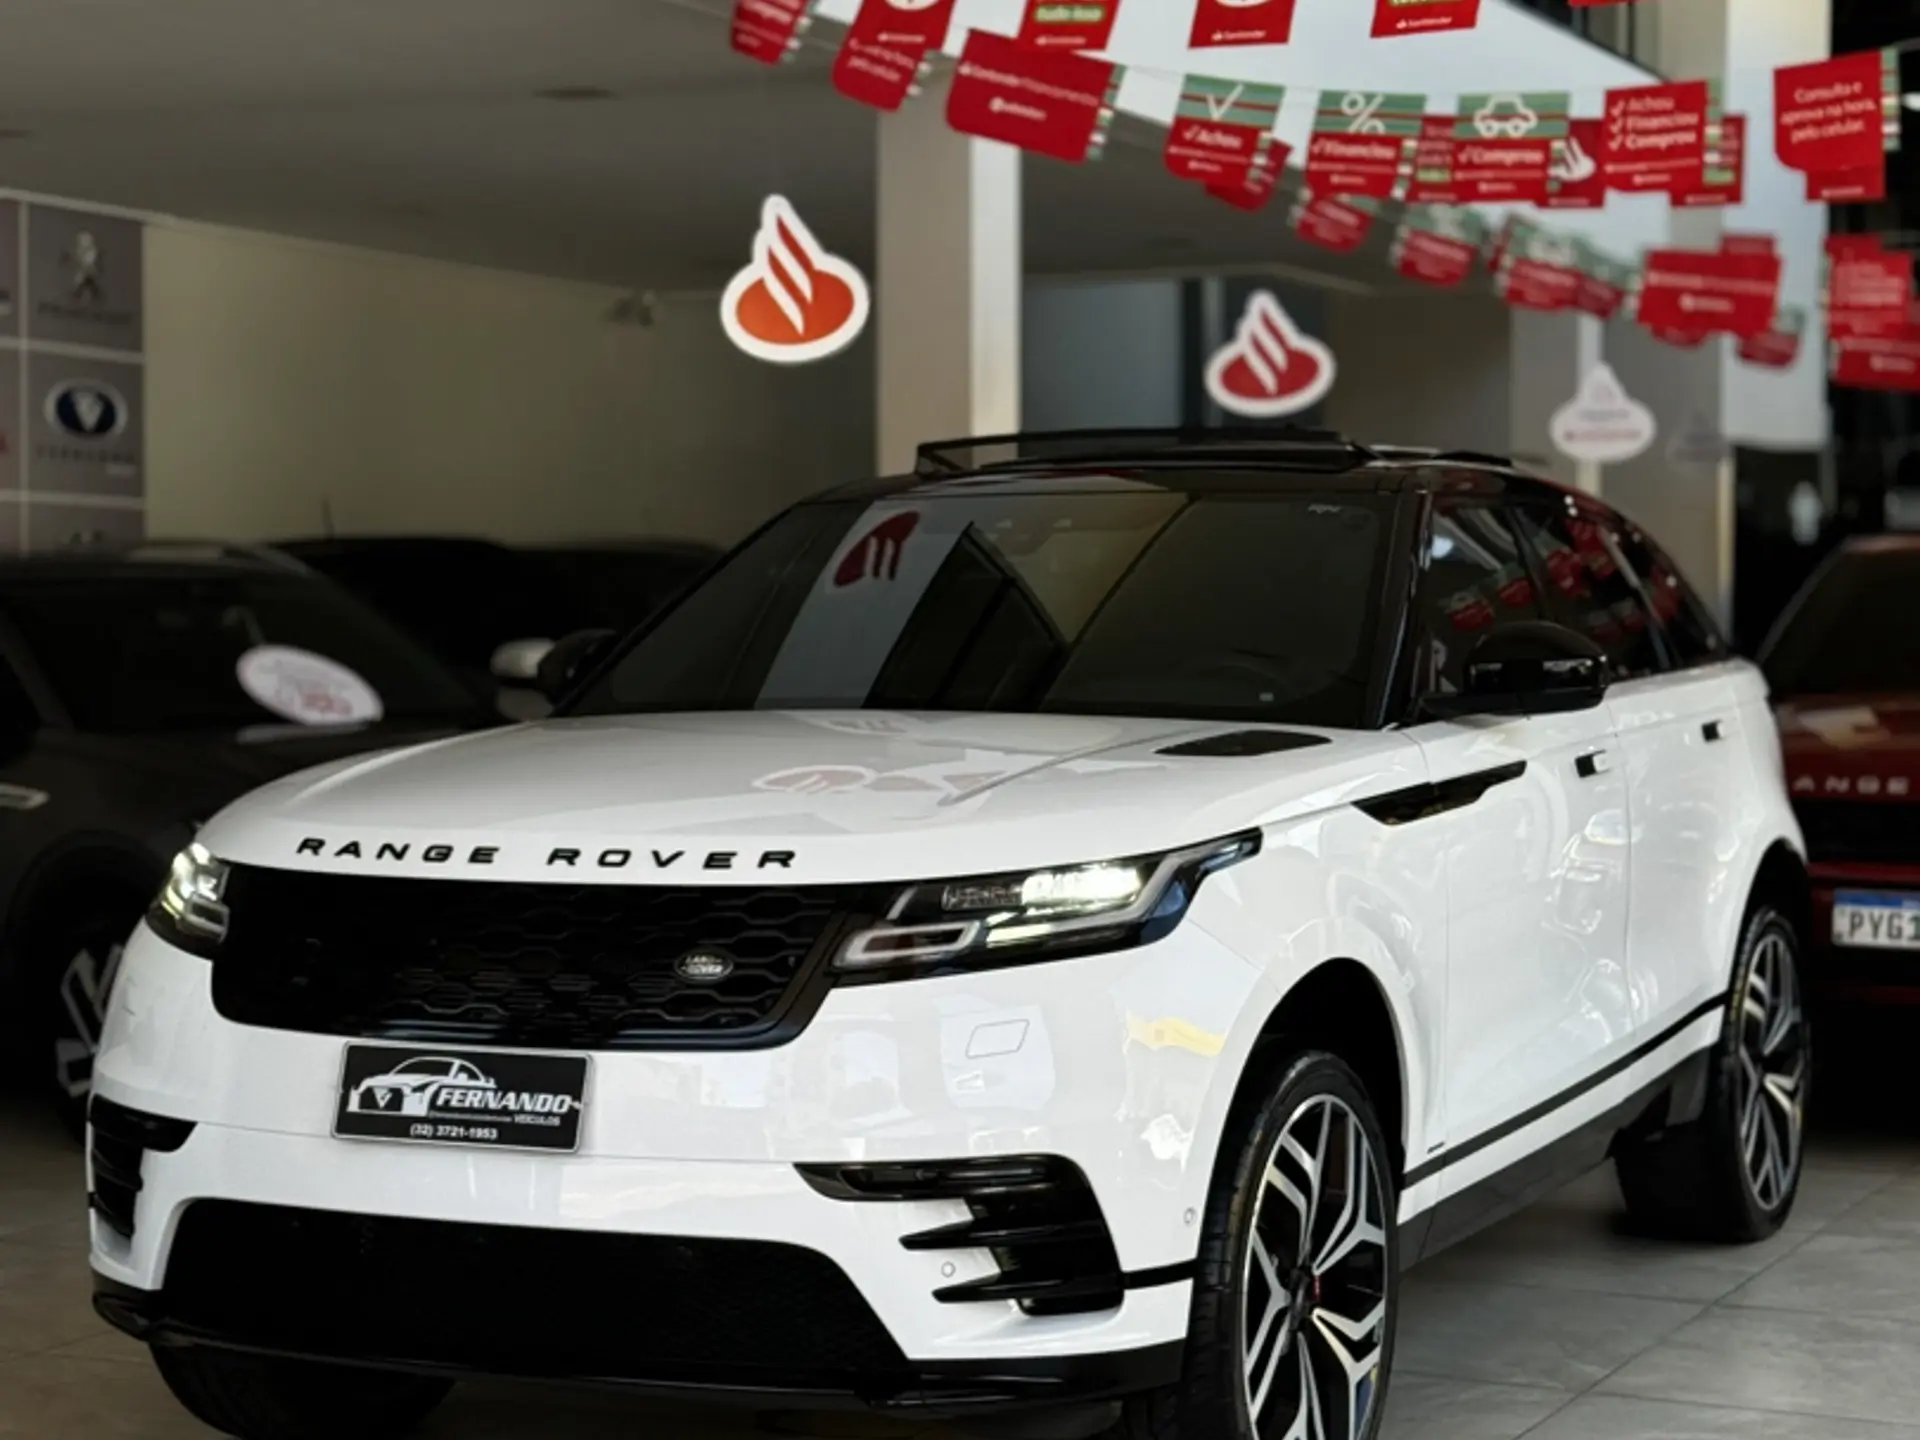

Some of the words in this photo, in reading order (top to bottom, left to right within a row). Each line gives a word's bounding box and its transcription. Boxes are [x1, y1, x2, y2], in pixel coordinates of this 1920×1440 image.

[1794, 82, 1852, 104] Consulta
[1626, 97, 1675, 112] Achou
[1625, 112, 1700, 131] Financiou
[1624, 131, 1698, 151] Comprou
[1790, 125, 1821, 144] pelo
[1794, 776, 1909, 795] ANGE
[296, 837, 500, 865] RANGE
[546, 848, 797, 869] ROVER
[436, 1087, 572, 1114] FERNANDO
[410, 1124, 434, 1138] (32)
[435, 1125, 499, 1140] 3721-1953
